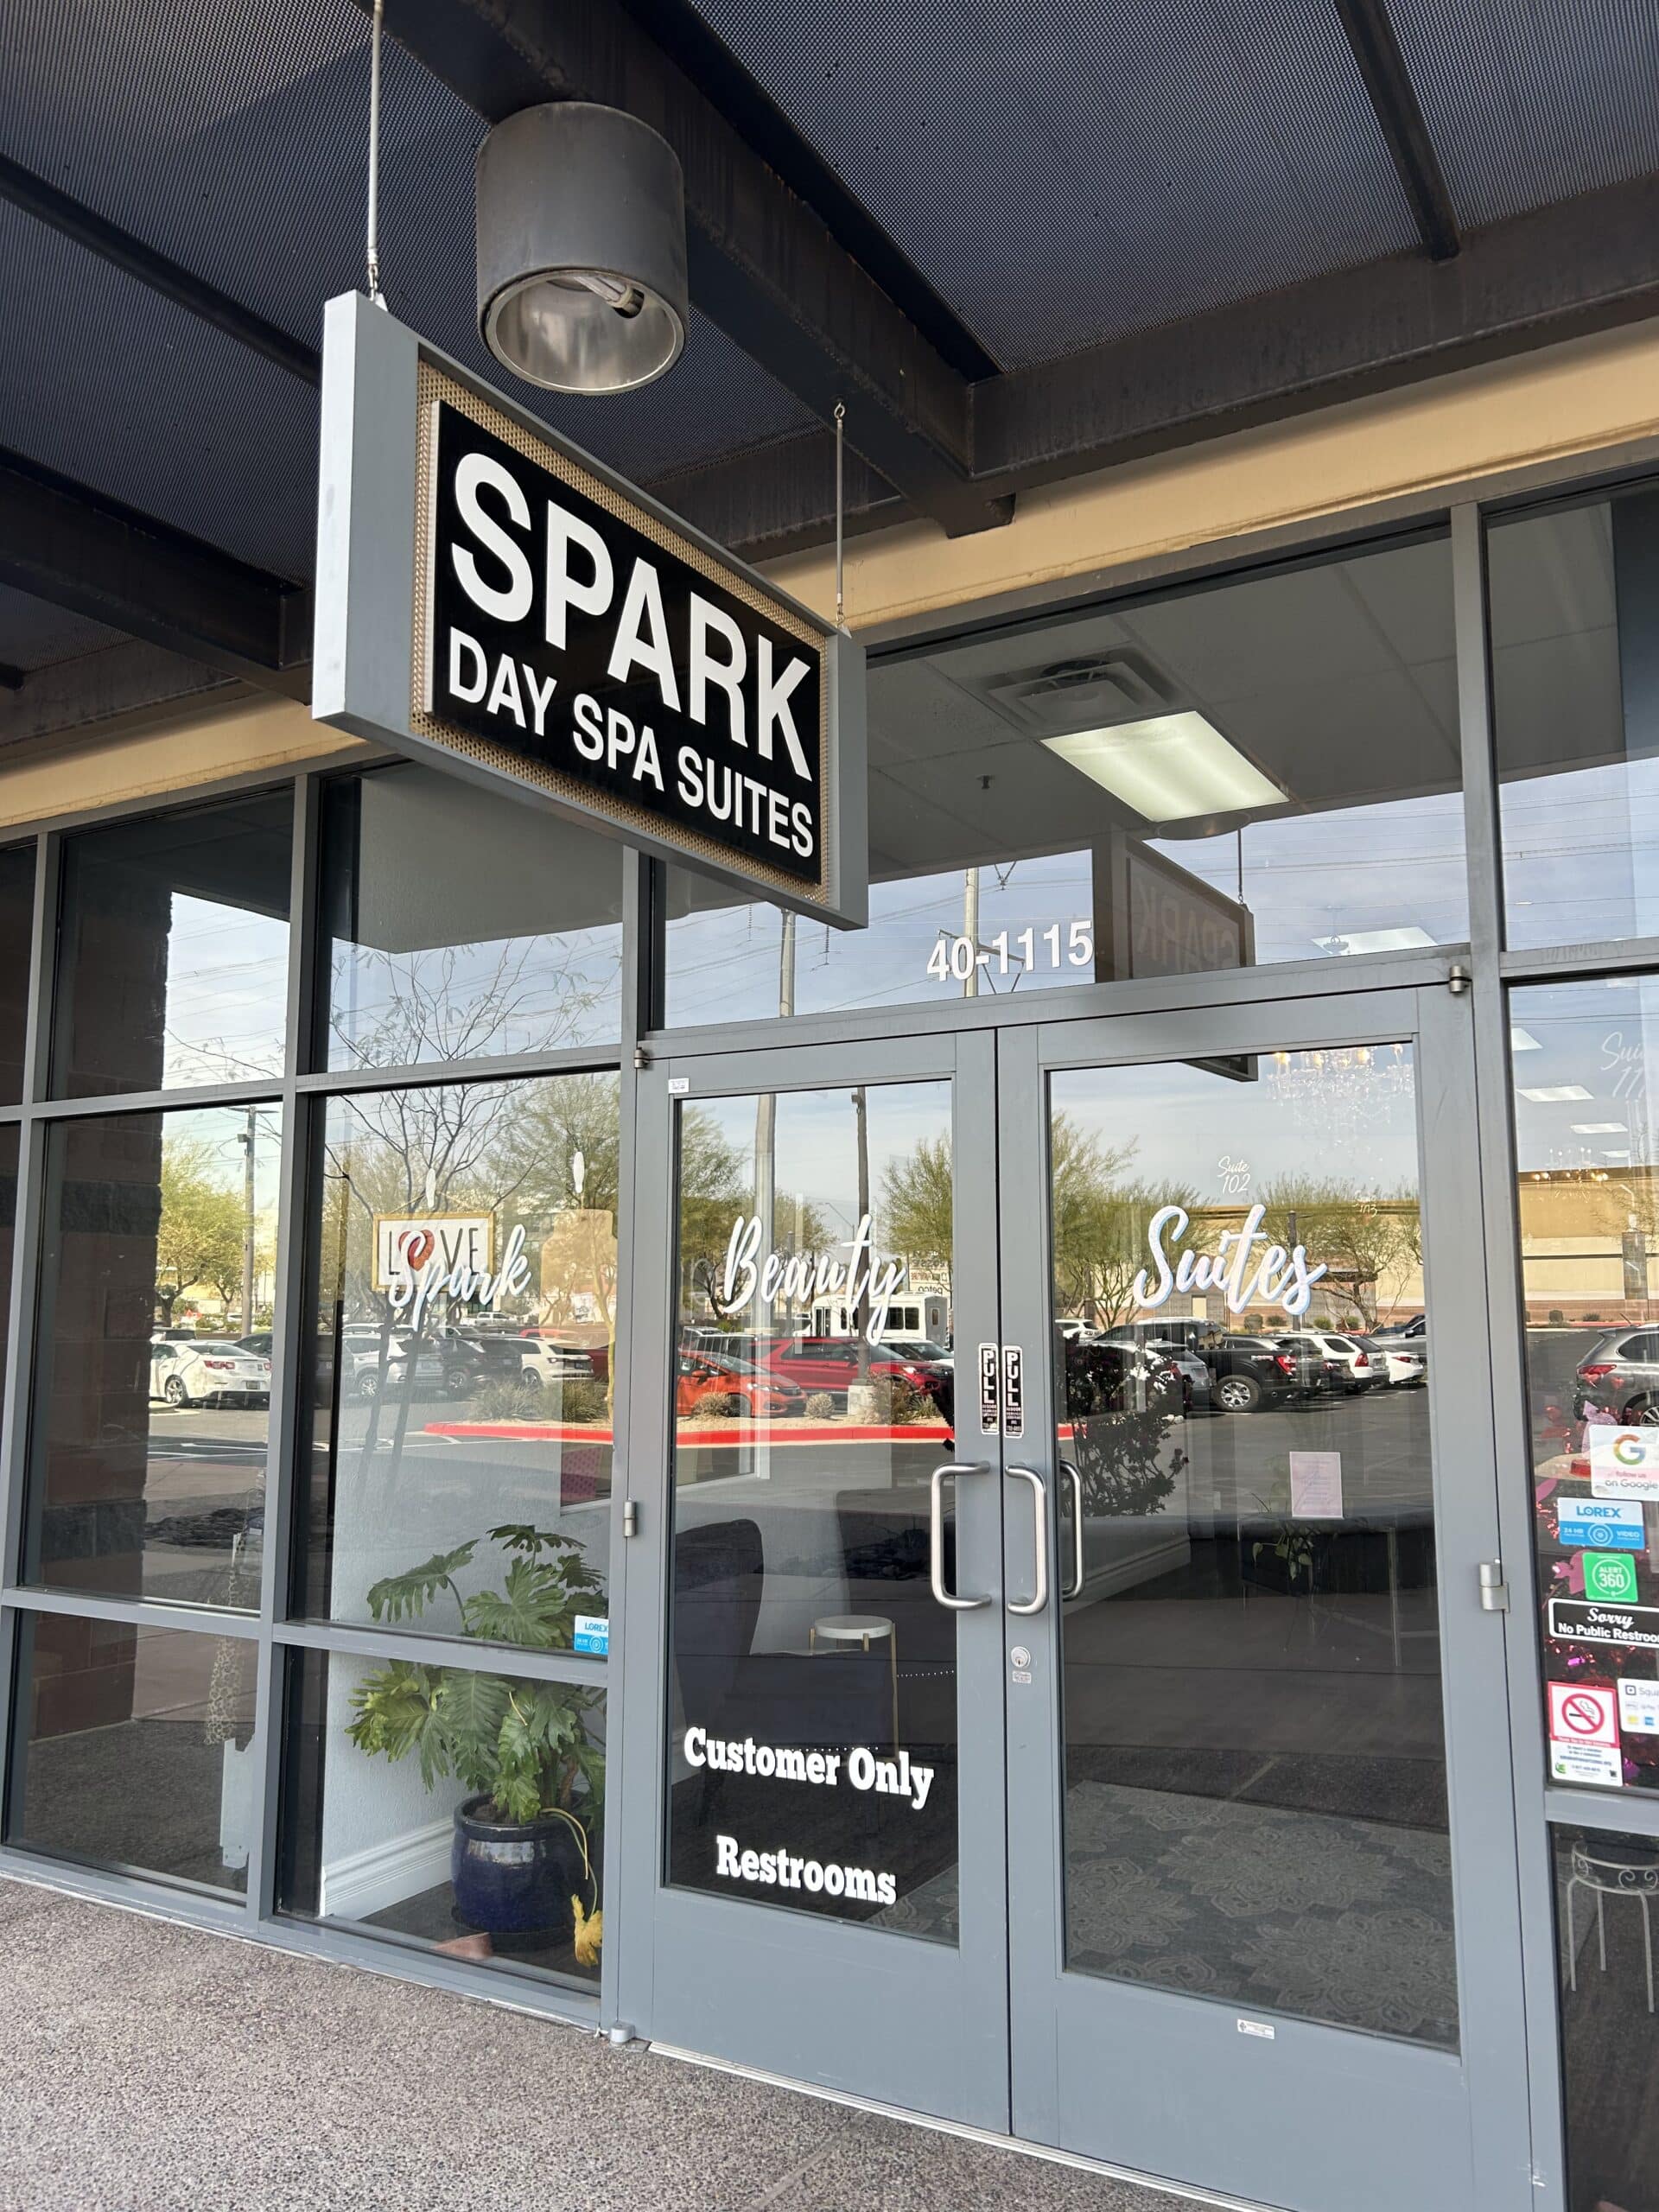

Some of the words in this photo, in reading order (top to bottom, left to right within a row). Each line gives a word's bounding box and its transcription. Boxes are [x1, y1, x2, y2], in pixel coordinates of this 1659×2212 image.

[452, 453, 812, 781] SPARK
[449, 626, 557, 736] DAY
[573, 693, 664, 791] SPA
[677, 746, 813, 857] SUITES
[926, 920, 1093, 982] 40-1115
[1600, 1031, 1643, 1071] Sui
[1217, 1155, 1250, 1177] Suite
[1222, 1173, 1250, 1194] 102
[389, 1224, 531, 1332] Spark
[723, 1214, 906, 1346] Beauty
[1133, 1204, 1328, 1315] Suites
[982, 1350, 995, 1404] PULL
[1007, 1352, 1019, 1407] PULL
[1620, 1478, 1658, 1491] Google
[1576, 1505, 1622, 1518] LOREX
[1599, 1573, 1624, 1588] 360
[1558, 1622, 1573, 1634] No
[1576, 1624, 1611, 1638] Public
[1612, 1628, 1659, 1643] Restroo
[1586, 1607, 1635, 1630] Sorry
[684, 1726, 841, 1785] Customer
[849, 1747, 934, 1809] Only
[716, 1834, 896, 1905] Restrooms
